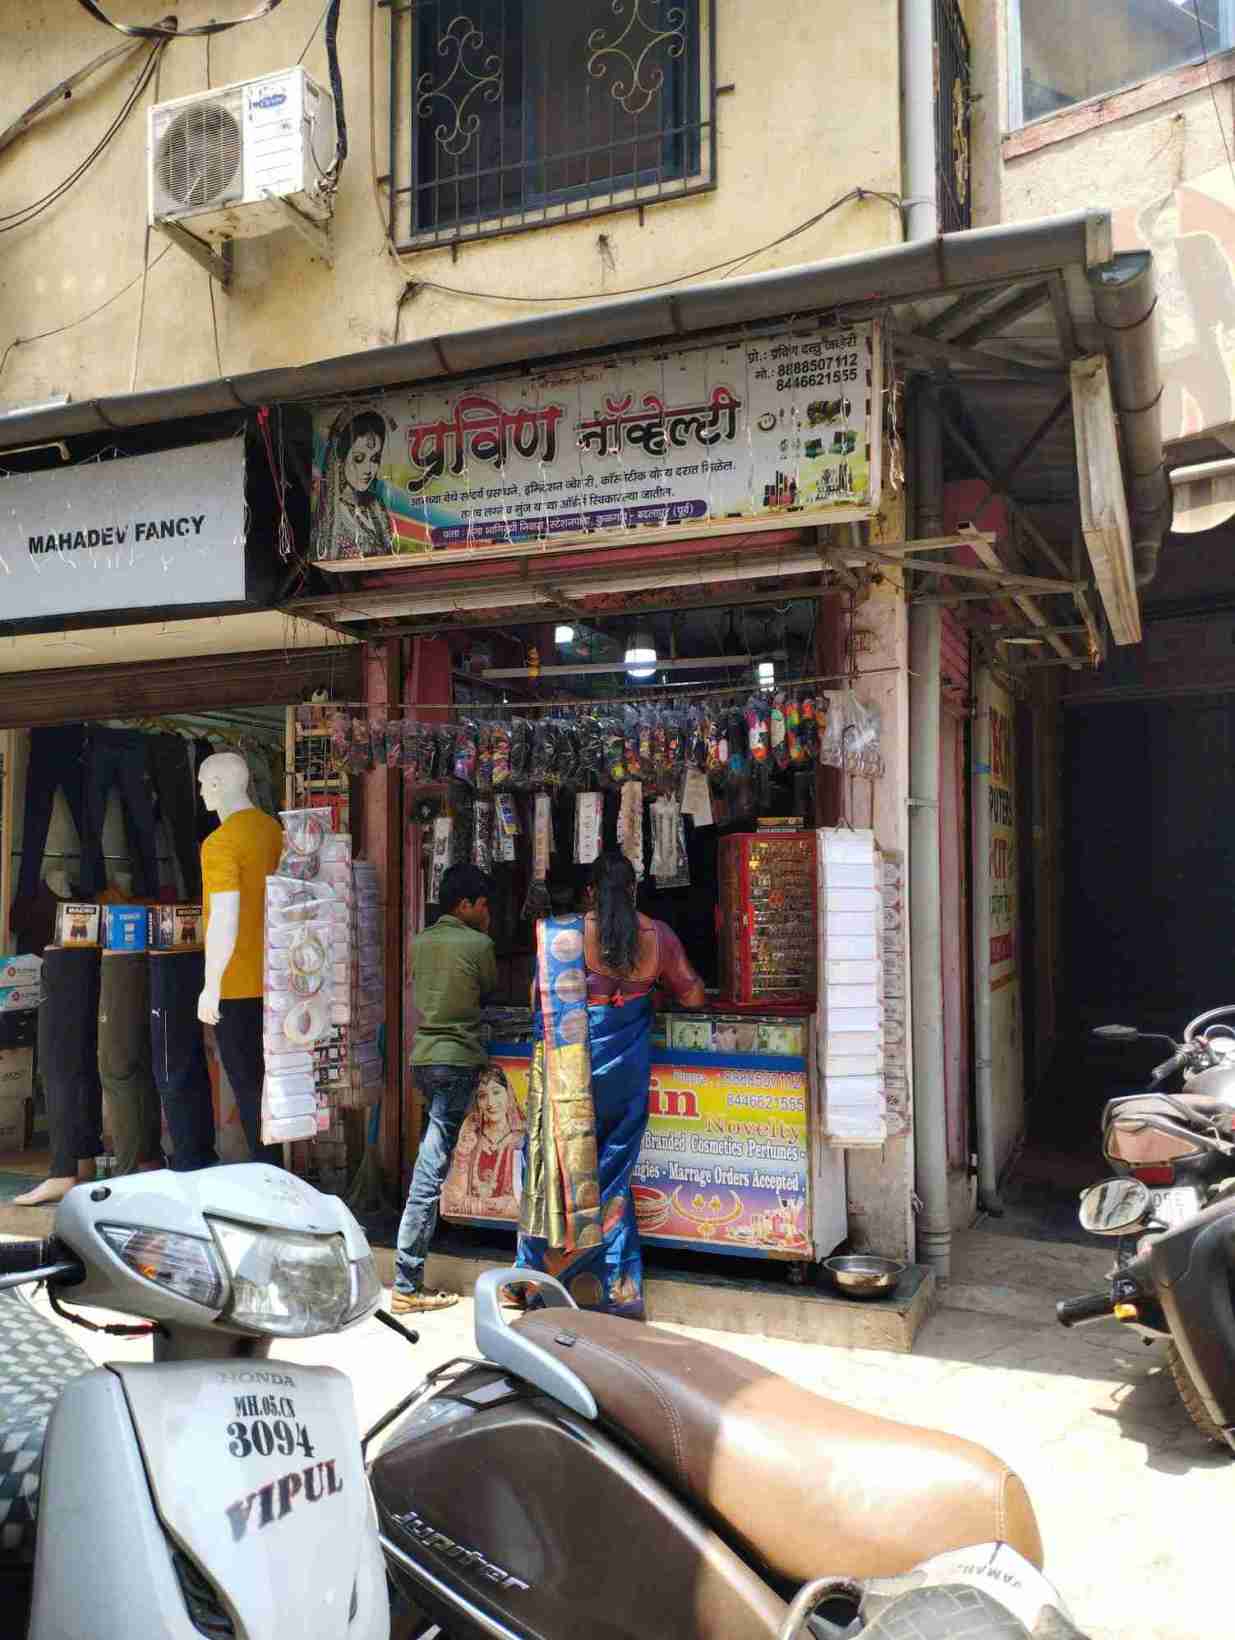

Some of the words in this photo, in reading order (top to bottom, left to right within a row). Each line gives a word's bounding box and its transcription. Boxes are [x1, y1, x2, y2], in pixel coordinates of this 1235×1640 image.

[777, 353, 858, 378] 8888507112
[776, 368, 858, 392] 8446621555
[406, 394, 563, 493] प्रविण
[573, 384, 742, 456] नॉव्हेल्टी
[29, 525, 129, 555] MAHADEV
[135, 515, 207, 542] FANCY
[703, 1114, 801, 1145] Novelty
[747, 1141, 801, 1162] Perfumes
[714, 1166, 750, 1184] Orders
[752, 1170, 799, 1191] Accepted
[216, 1371, 297, 1388] HONDA
[226, 1419, 315, 1459] 3094
[224, 1458, 344, 1544] VIPUL
